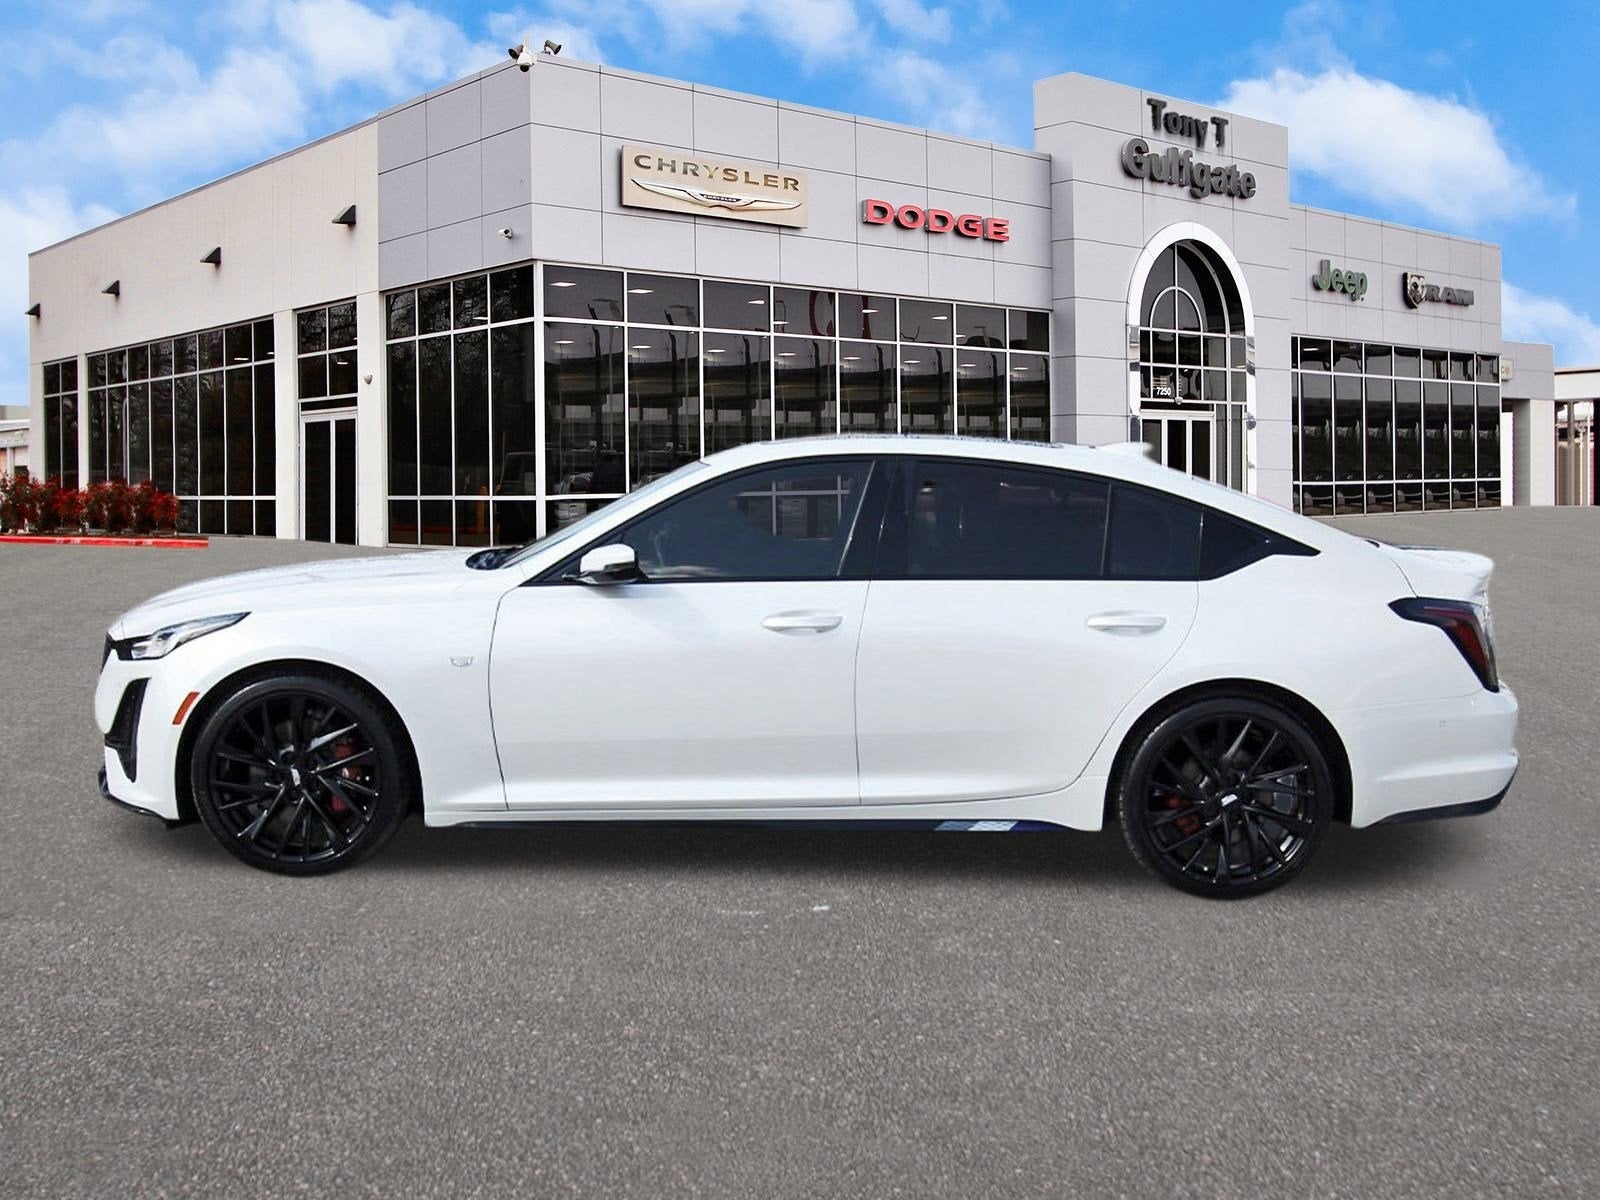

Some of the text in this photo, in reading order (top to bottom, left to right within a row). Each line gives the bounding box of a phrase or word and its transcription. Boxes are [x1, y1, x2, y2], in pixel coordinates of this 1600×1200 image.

[1147, 98, 1229, 147] Tony T
[634, 154, 800, 192] CHRYSLER
[1121, 138, 1257, 199] Gulfgate
[862, 198, 1010, 242] DODGE
[1312, 259, 1368, 302] Jeep
[1424, 283, 1475, 306] RAM
[1156, 387, 1171, 396] 7250
